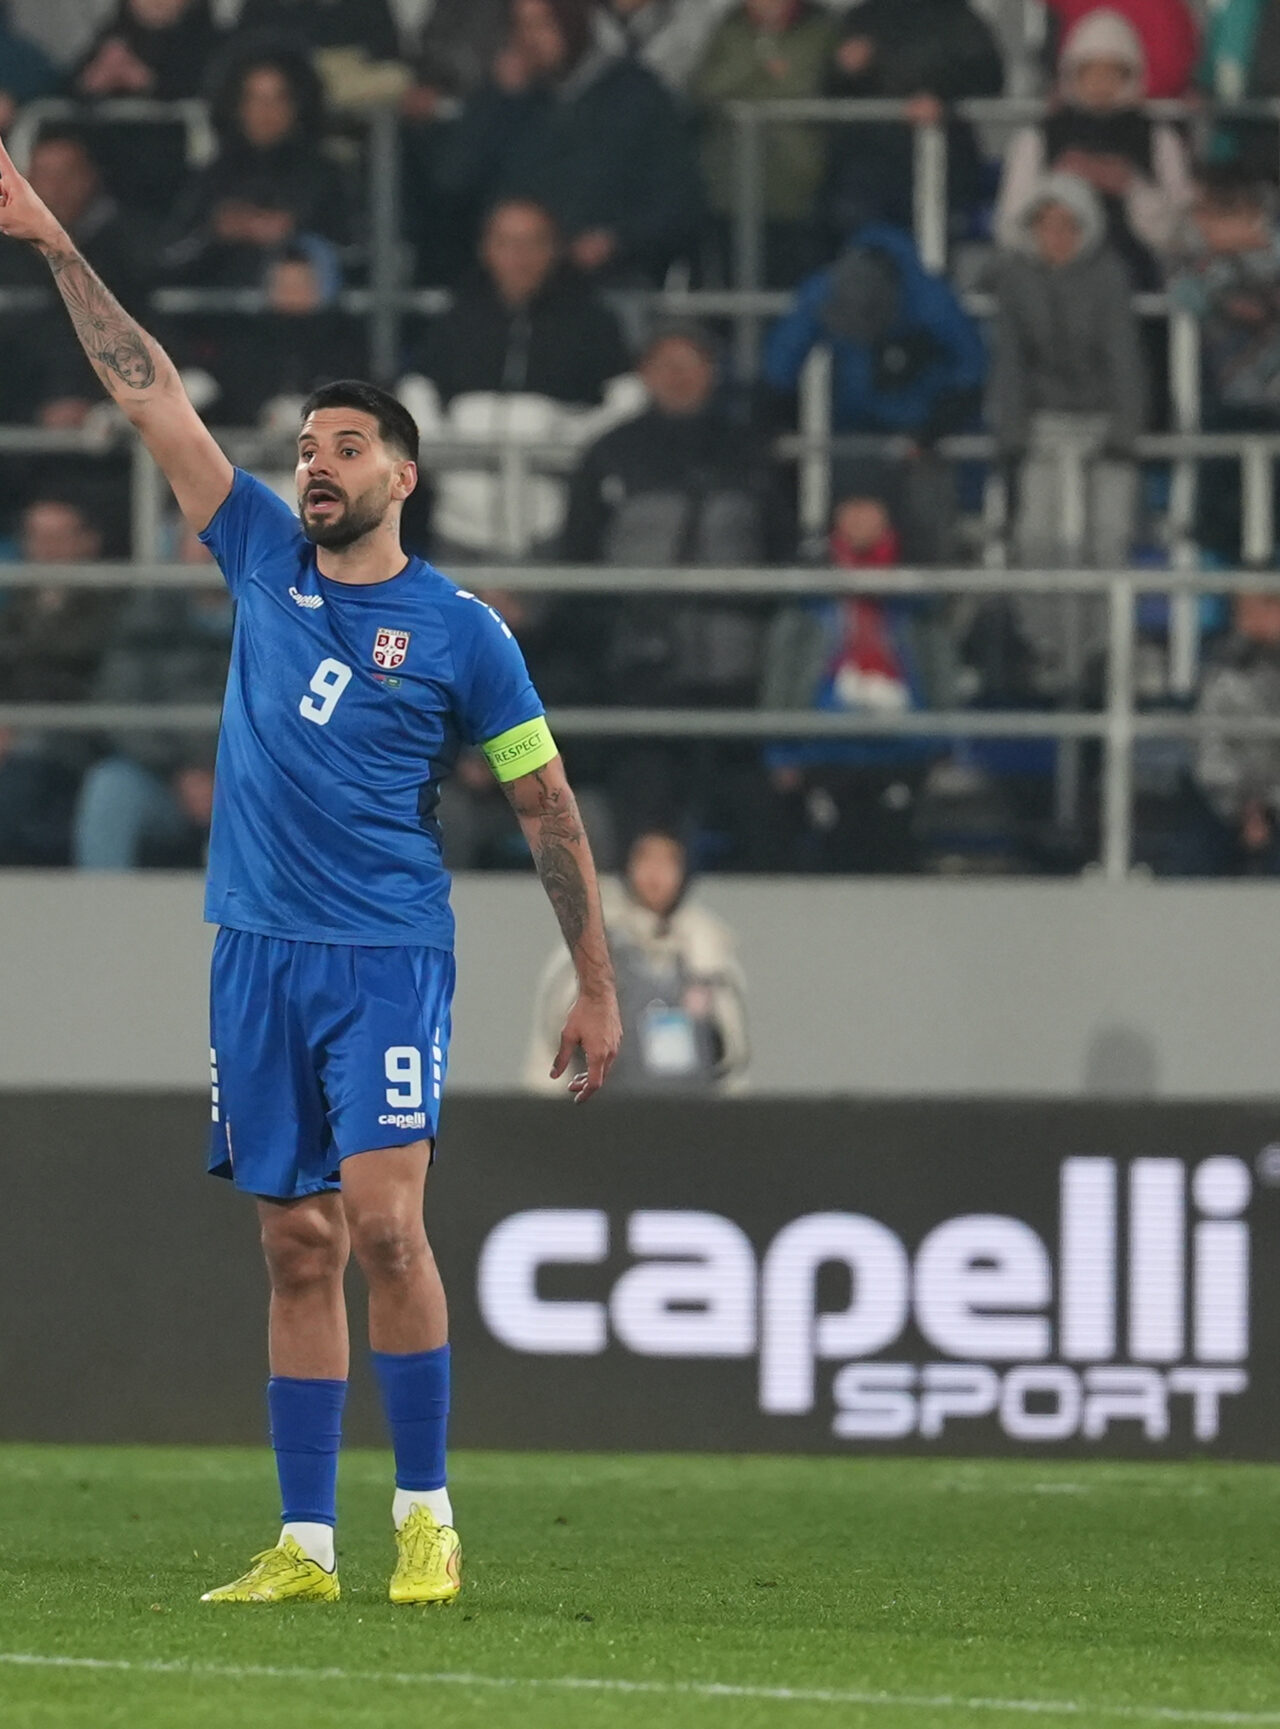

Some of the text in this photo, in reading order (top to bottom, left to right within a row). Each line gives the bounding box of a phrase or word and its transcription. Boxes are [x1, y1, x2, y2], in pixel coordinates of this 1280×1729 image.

[299, 657, 353, 726] 9
[494, 733, 543, 763] RESPECT
[384, 1046, 423, 1108] 9
[378, 1112, 426, 1128] capelli
[477, 1155, 1251, 1414] capelli
[832, 1362, 1249, 1441] SPORT
